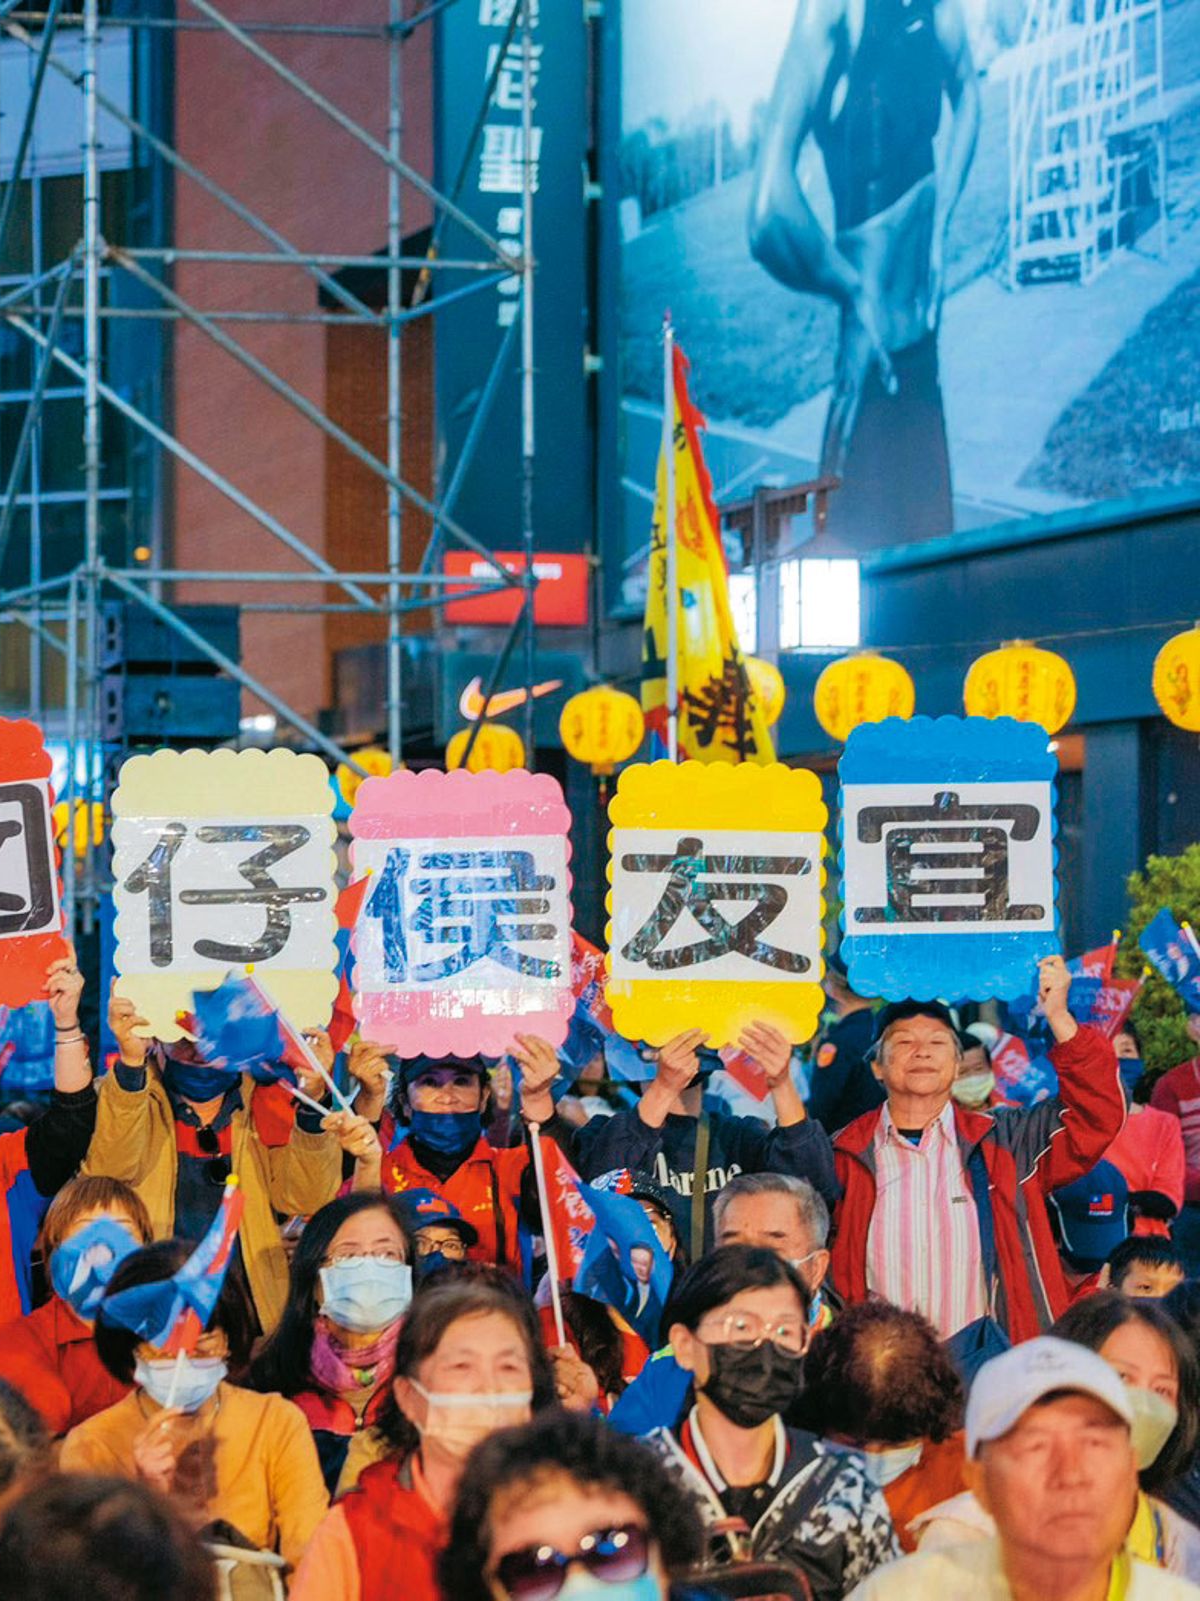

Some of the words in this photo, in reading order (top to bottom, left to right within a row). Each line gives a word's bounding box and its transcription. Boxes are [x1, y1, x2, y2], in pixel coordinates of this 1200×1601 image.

[123, 821, 327, 967] 仔
[364, 847, 562, 984] 侯
[621, 837, 812, 974] 友
[854, 791, 1046, 922] 宜
